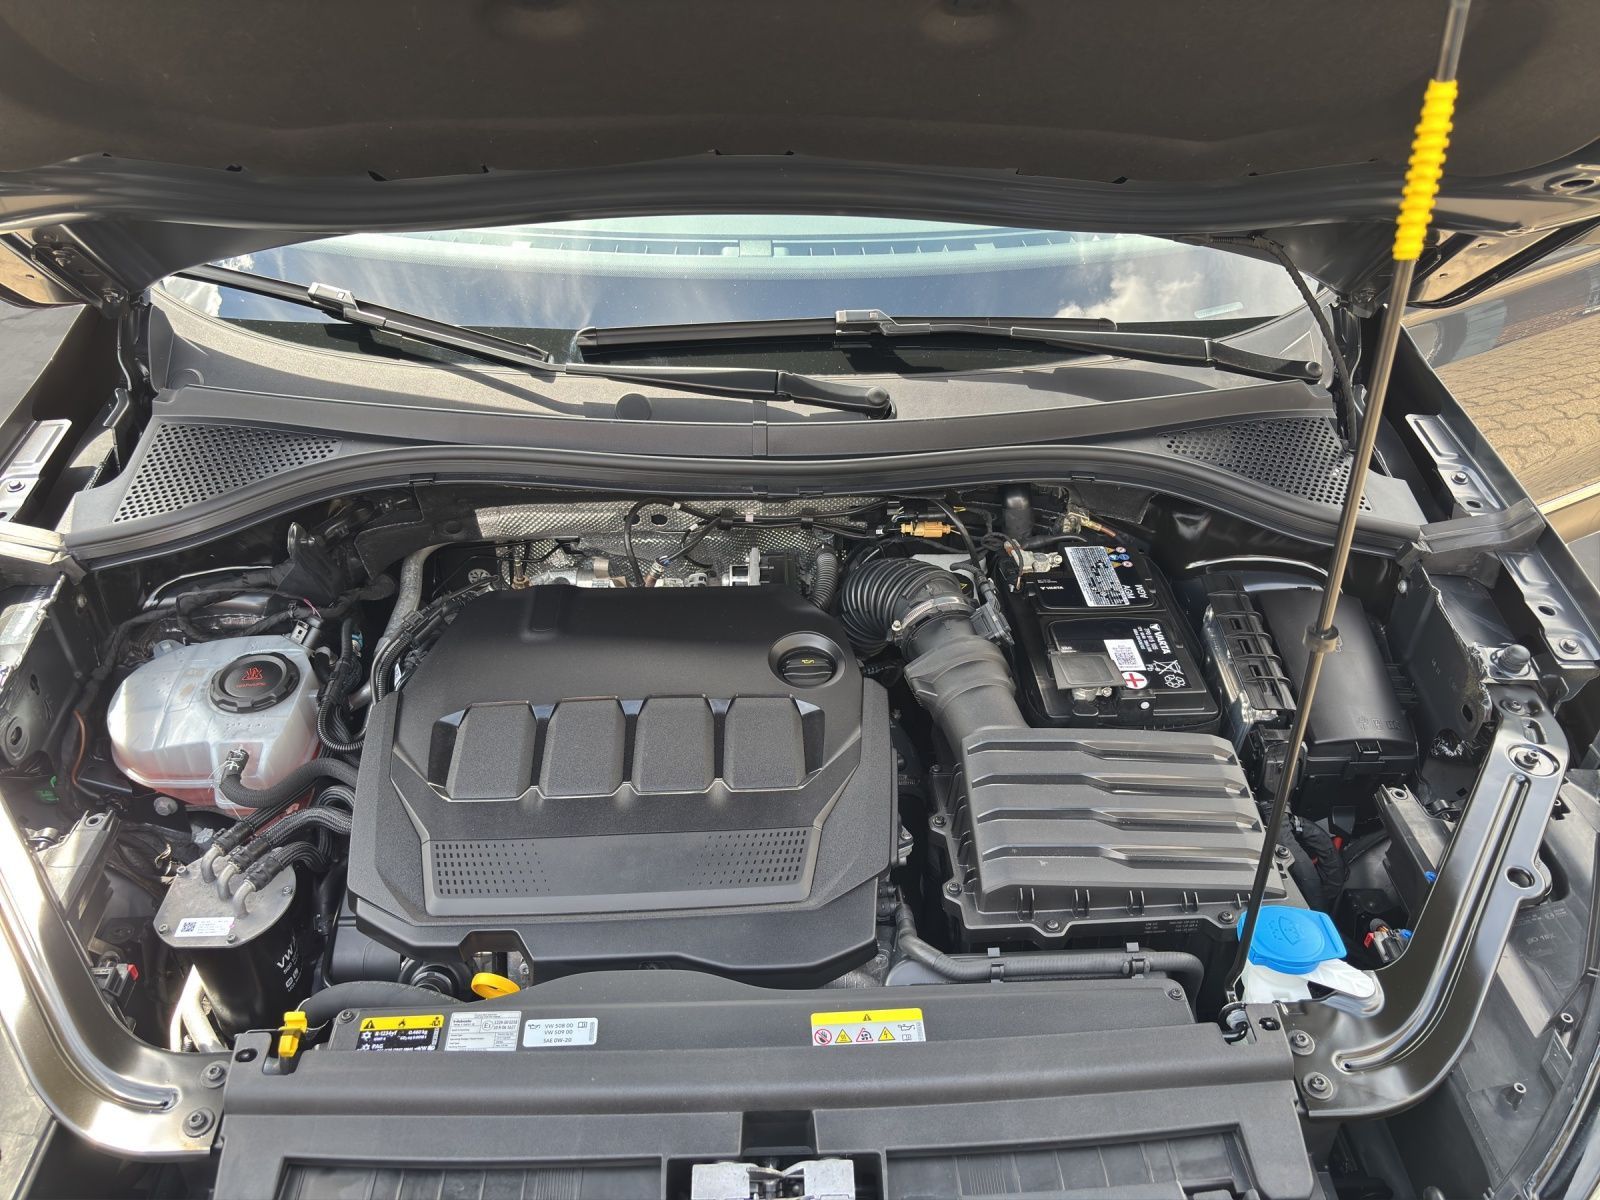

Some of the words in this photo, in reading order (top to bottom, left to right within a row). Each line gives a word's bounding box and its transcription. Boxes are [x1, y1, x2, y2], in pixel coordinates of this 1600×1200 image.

[1122, 584, 1136, 599] AGM
[1134, 584, 1149, 599] AGM
[1154, 631, 1172, 654] VARTA
[276, 944, 293, 968] VW
